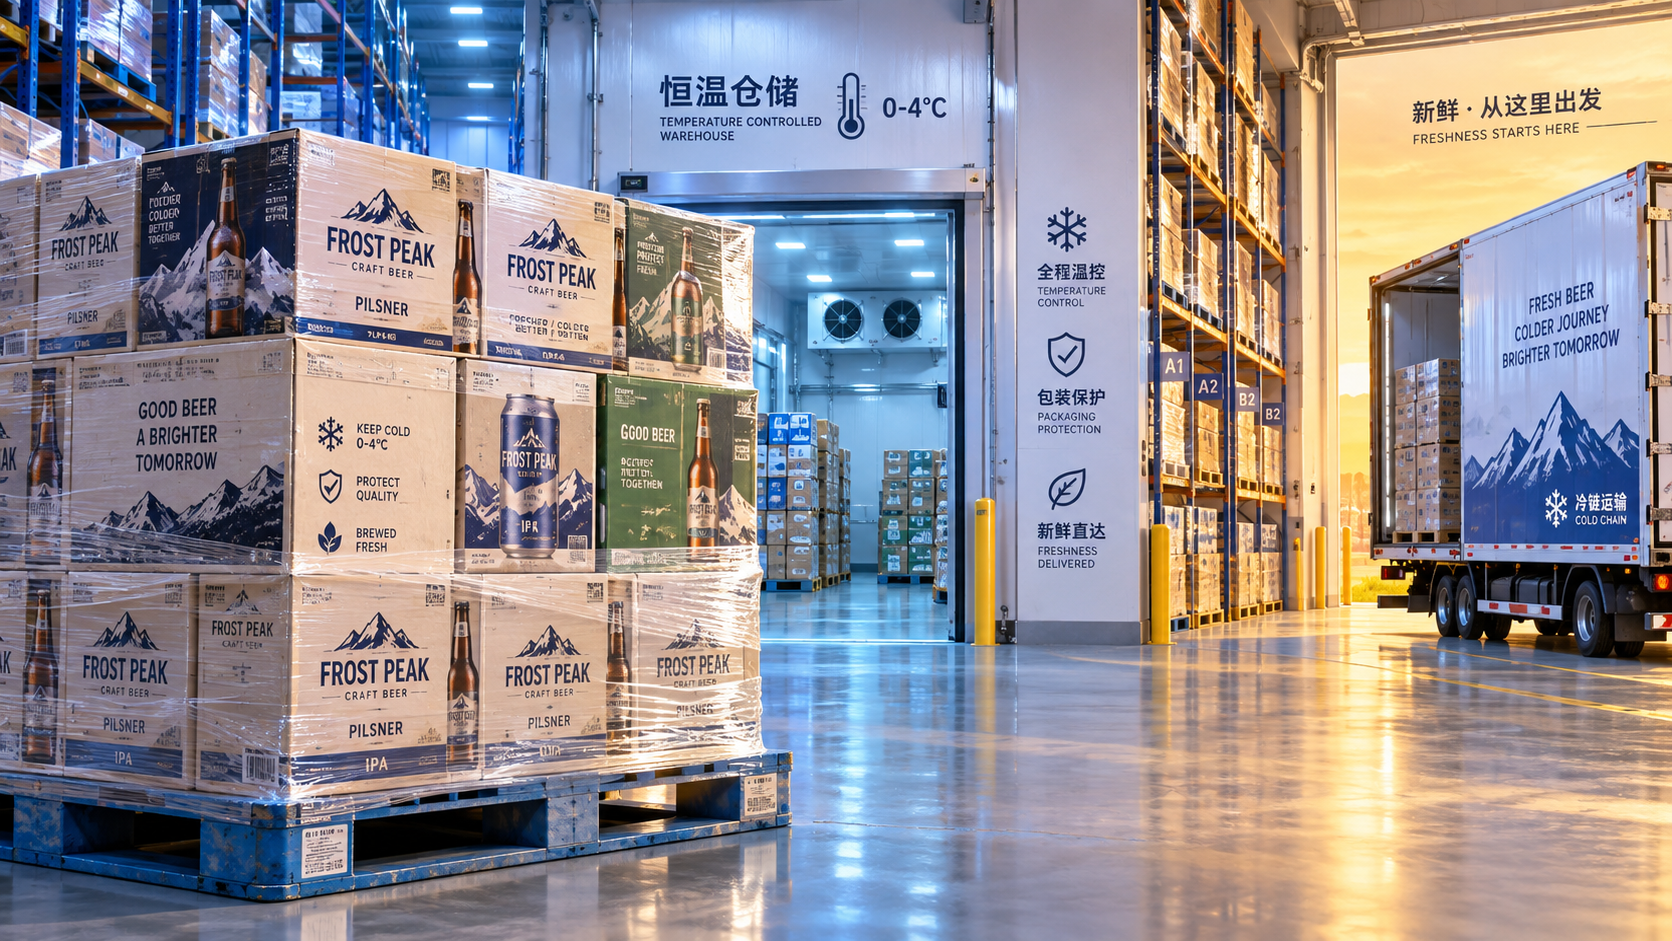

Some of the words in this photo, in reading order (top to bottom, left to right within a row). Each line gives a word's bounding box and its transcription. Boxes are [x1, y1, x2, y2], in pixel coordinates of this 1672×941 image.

[660, 74, 799, 108] 恒温仓储
[882, 96, 947, 118] 0-4°C
[660, 116, 743, 127] TEMPERATURE
[746, 116, 822, 127] CONTROLLED
[660, 131, 734, 141] WAREHOUSE
[1413, 130, 1488, 145] FRESHNESS
[1492, 126, 1540, 140] STARTS
[1546, 122, 1580, 136] HERE
[51, 234, 88, 260] FROST
[88, 230, 119, 254] PEAK
[327, 226, 385, 260] FROST
[390, 238, 436, 268] PEAK
[352, 261, 384, 275] CRAFT
[389, 268, 414, 280] BEER
[508, 254, 555, 283] FROST
[559, 262, 596, 290] PEAK
[1038, 263, 1106, 280] 全程温控
[528, 284, 554, 297] CRAFT
[558, 288, 578, 300] BEER
[1038, 286, 1106, 295] TEMPERATURE
[1529, 290, 1562, 315] FRESH
[1566, 282, 1594, 306] BEER
[356, 296, 408, 317] PILSNER
[1038, 298, 1084, 307] CONTROL
[1514, 318, 1554, 342] COLDER
[1557, 304, 1609, 332] JOURNEY
[1502, 344, 1550, 368] BRIGHTER
[1553, 328, 1620, 358] TOMORROW
[1165, 358, 1184, 374] A1
[1198, 379, 1218, 394] A2
[1038, 388, 1106, 406] 包装保护
[1239, 392, 1255, 406] B2
[138, 400, 177, 420] GOOD
[182, 397, 216, 418] BEER
[1265, 408, 1280, 420] B2
[1038, 412, 1096, 422] PACKAGING
[136, 428, 145, 446] A
[150, 424, 218, 446] BRIGHTER
[357, 424, 382, 436] KEEP
[384, 426, 410, 437] COLD
[652, 427, 676, 443] BEER
[1038, 424, 1101, 434] PROTECTION
[136, 452, 218, 472] TOMORROW
[502, 450, 532, 468] FROST
[534, 452, 557, 471] PEAK
[356, 476, 400, 488] PROTECT
[356, 490, 399, 502] QUALITY
[1575, 492, 1628, 512] 冷链运输
[1575, 516, 1598, 526] COLD
[1600, 515, 1627, 525] CHAIN
[356, 528, 396, 538] BREWED
[1038, 522, 1106, 540] 新鲜直达
[356, 542, 388, 552] FRESH
[1038, 546, 1098, 556] FRESHNESS
[1038, 559, 1095, 568] DELIVERED
[212, 620, 244, 636] FROST
[246, 621, 274, 637] PEAK
[83, 654, 126, 681] FROST
[130, 658, 168, 685] PEAK
[320, 660, 378, 687] FROST
[384, 657, 430, 683] PEAK
[656, 656, 694, 678] FROST
[699, 654, 730, 674] PEAK
[506, 664, 550, 687] FROST
[554, 662, 590, 684] PEAK
[100, 686, 124, 696] CRAFT
[128, 687, 150, 698] BEER
[344, 690, 378, 700] CRAFT
[382, 688, 408, 699] BEER
[524, 689, 551, 698] CRAFT
[554, 688, 574, 697] BEER
[104, 717, 145, 734] PILSNER
[528, 714, 570, 729] PILSNER
[349, 721, 403, 739] PILSNER
[114, 750, 132, 766] IPA
[366, 756, 388, 772] IPA
